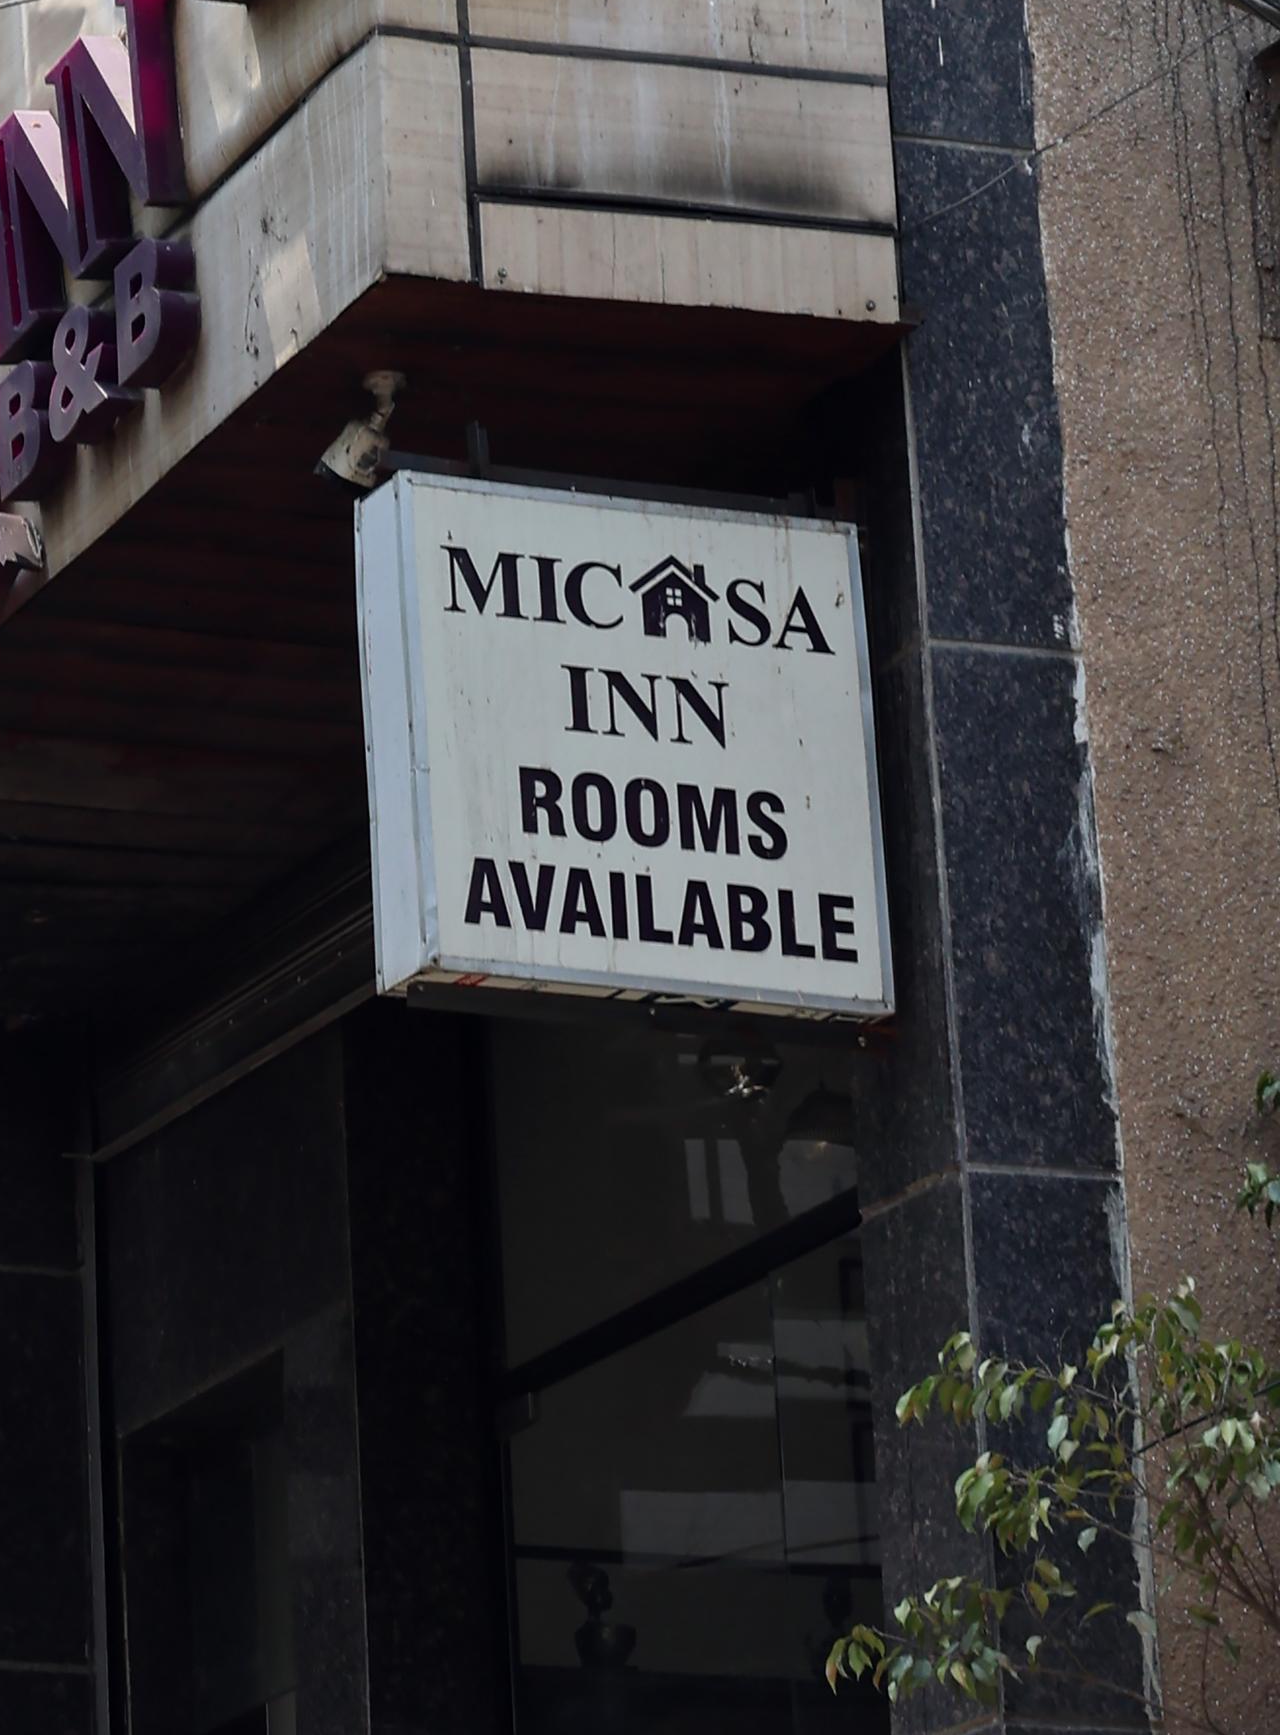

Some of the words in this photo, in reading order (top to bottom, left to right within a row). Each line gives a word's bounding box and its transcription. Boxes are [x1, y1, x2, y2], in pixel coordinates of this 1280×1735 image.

[561, 664, 729, 749] INN
[519, 766, 788, 860] ROOMS
[464, 857, 859, 962] AVAILABLE
